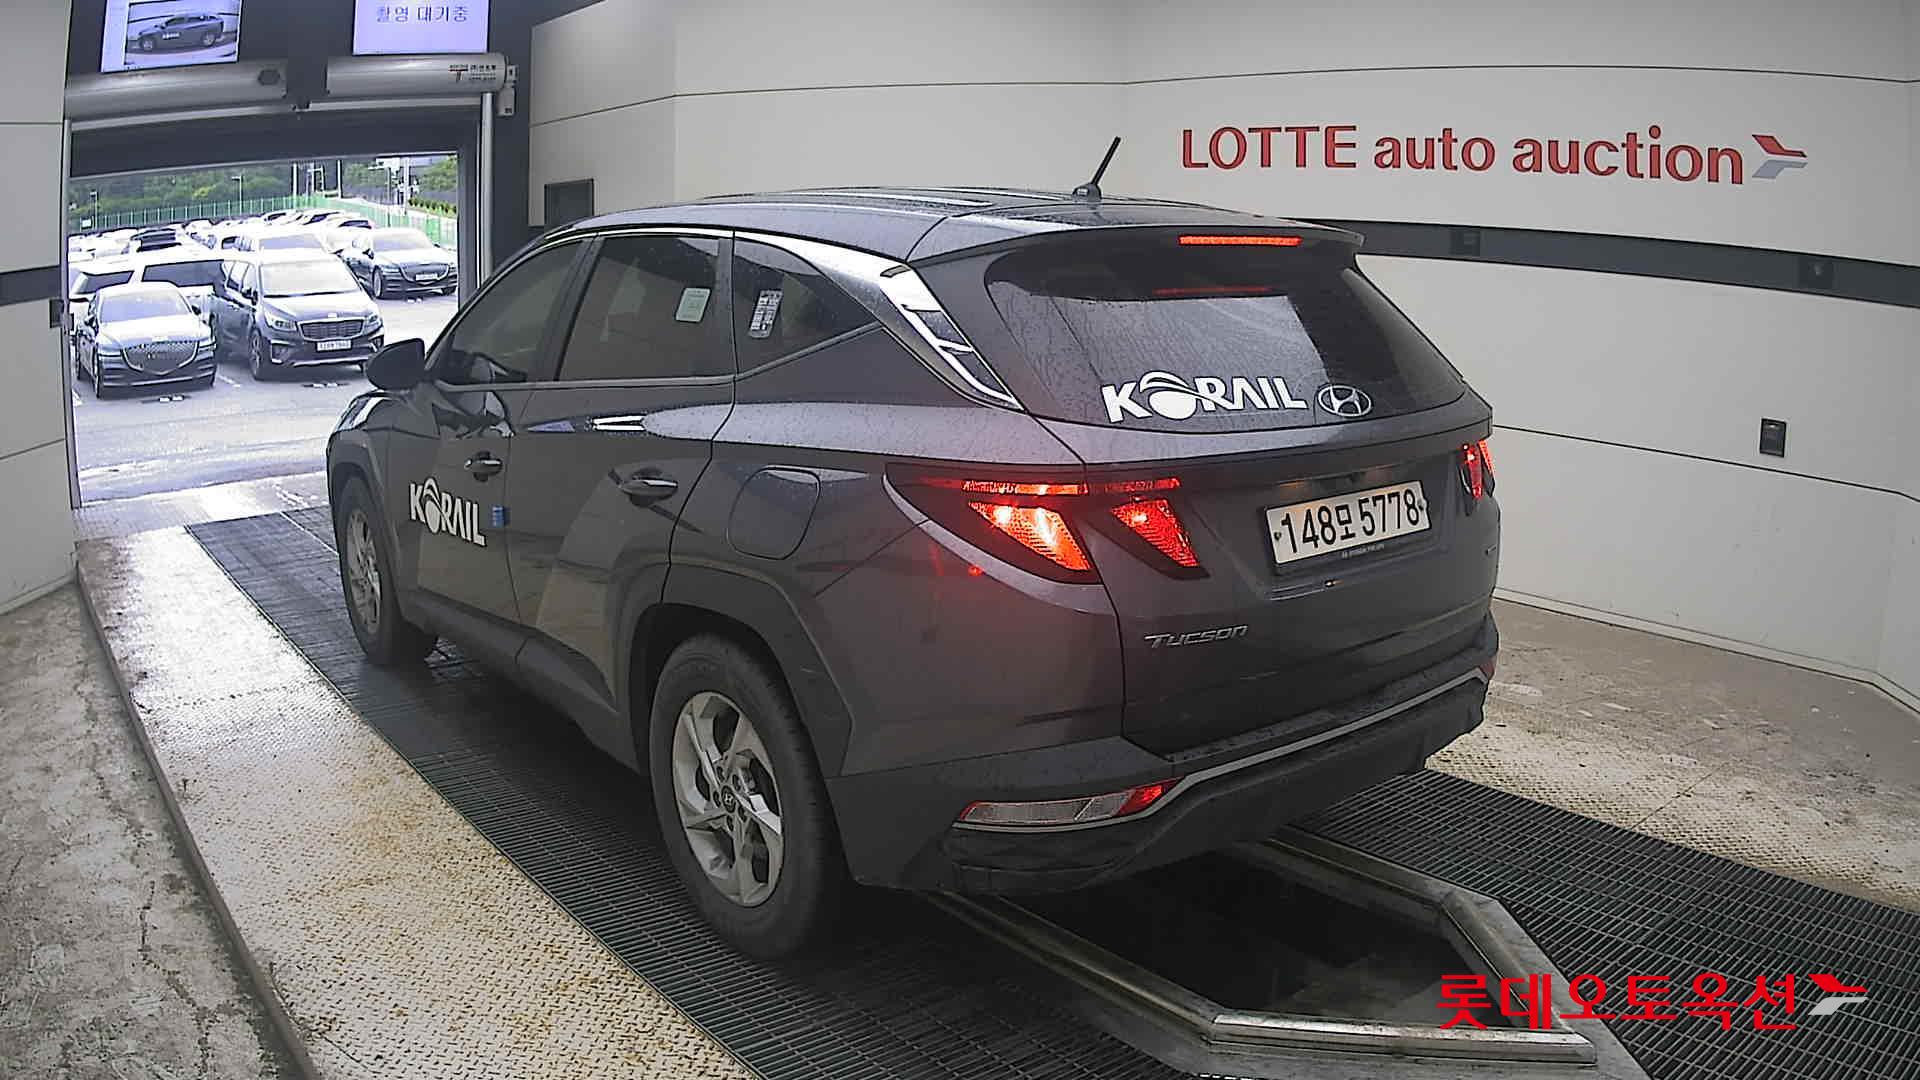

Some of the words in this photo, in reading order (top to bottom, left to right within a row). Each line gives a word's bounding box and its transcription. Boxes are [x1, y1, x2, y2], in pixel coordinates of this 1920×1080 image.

[417, 6, 468, 23] 대기중
[1182, 125, 1357, 170] LOTTE
[1373, 127, 1497, 172] auto
[1512, 124, 1744, 185] auction
[1101, 370, 1309, 424] KORAIL
[409, 477, 486, 547] KORAIL
